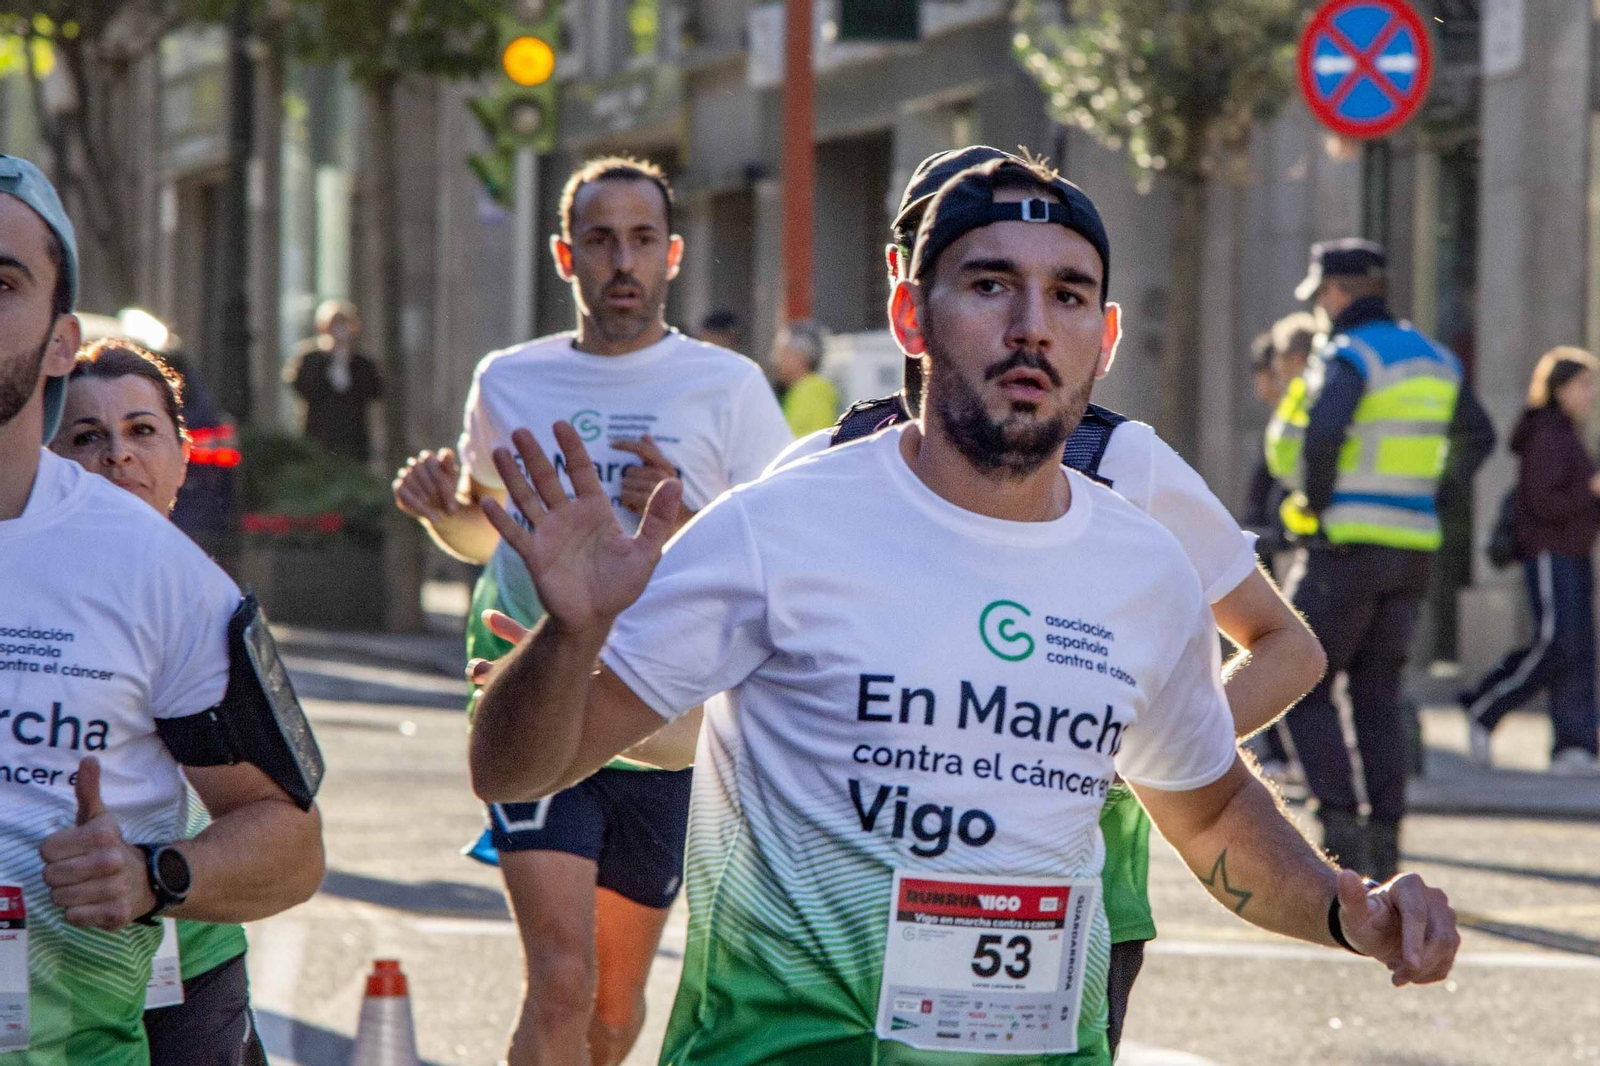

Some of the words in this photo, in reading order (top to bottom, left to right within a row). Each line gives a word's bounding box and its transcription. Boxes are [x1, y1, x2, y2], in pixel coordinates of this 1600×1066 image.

[1045, 614, 1115, 641] asociación
[1046, 632, 1108, 657] española
[43, 662, 58, 674] el
[61, 664, 115, 681] cáncer
[1047, 651, 1093, 671] contra
[1097, 661, 1107, 674] el
[857, 673, 936, 726] En
[958, 680, 1129, 757] March
[853, 743, 963, 776] contra
[973, 753, 1003, 781] el
[1011, 759, 1098, 797] cáncer
[848, 778, 996, 858] Vigo
[971, 933, 1033, 979] 53
